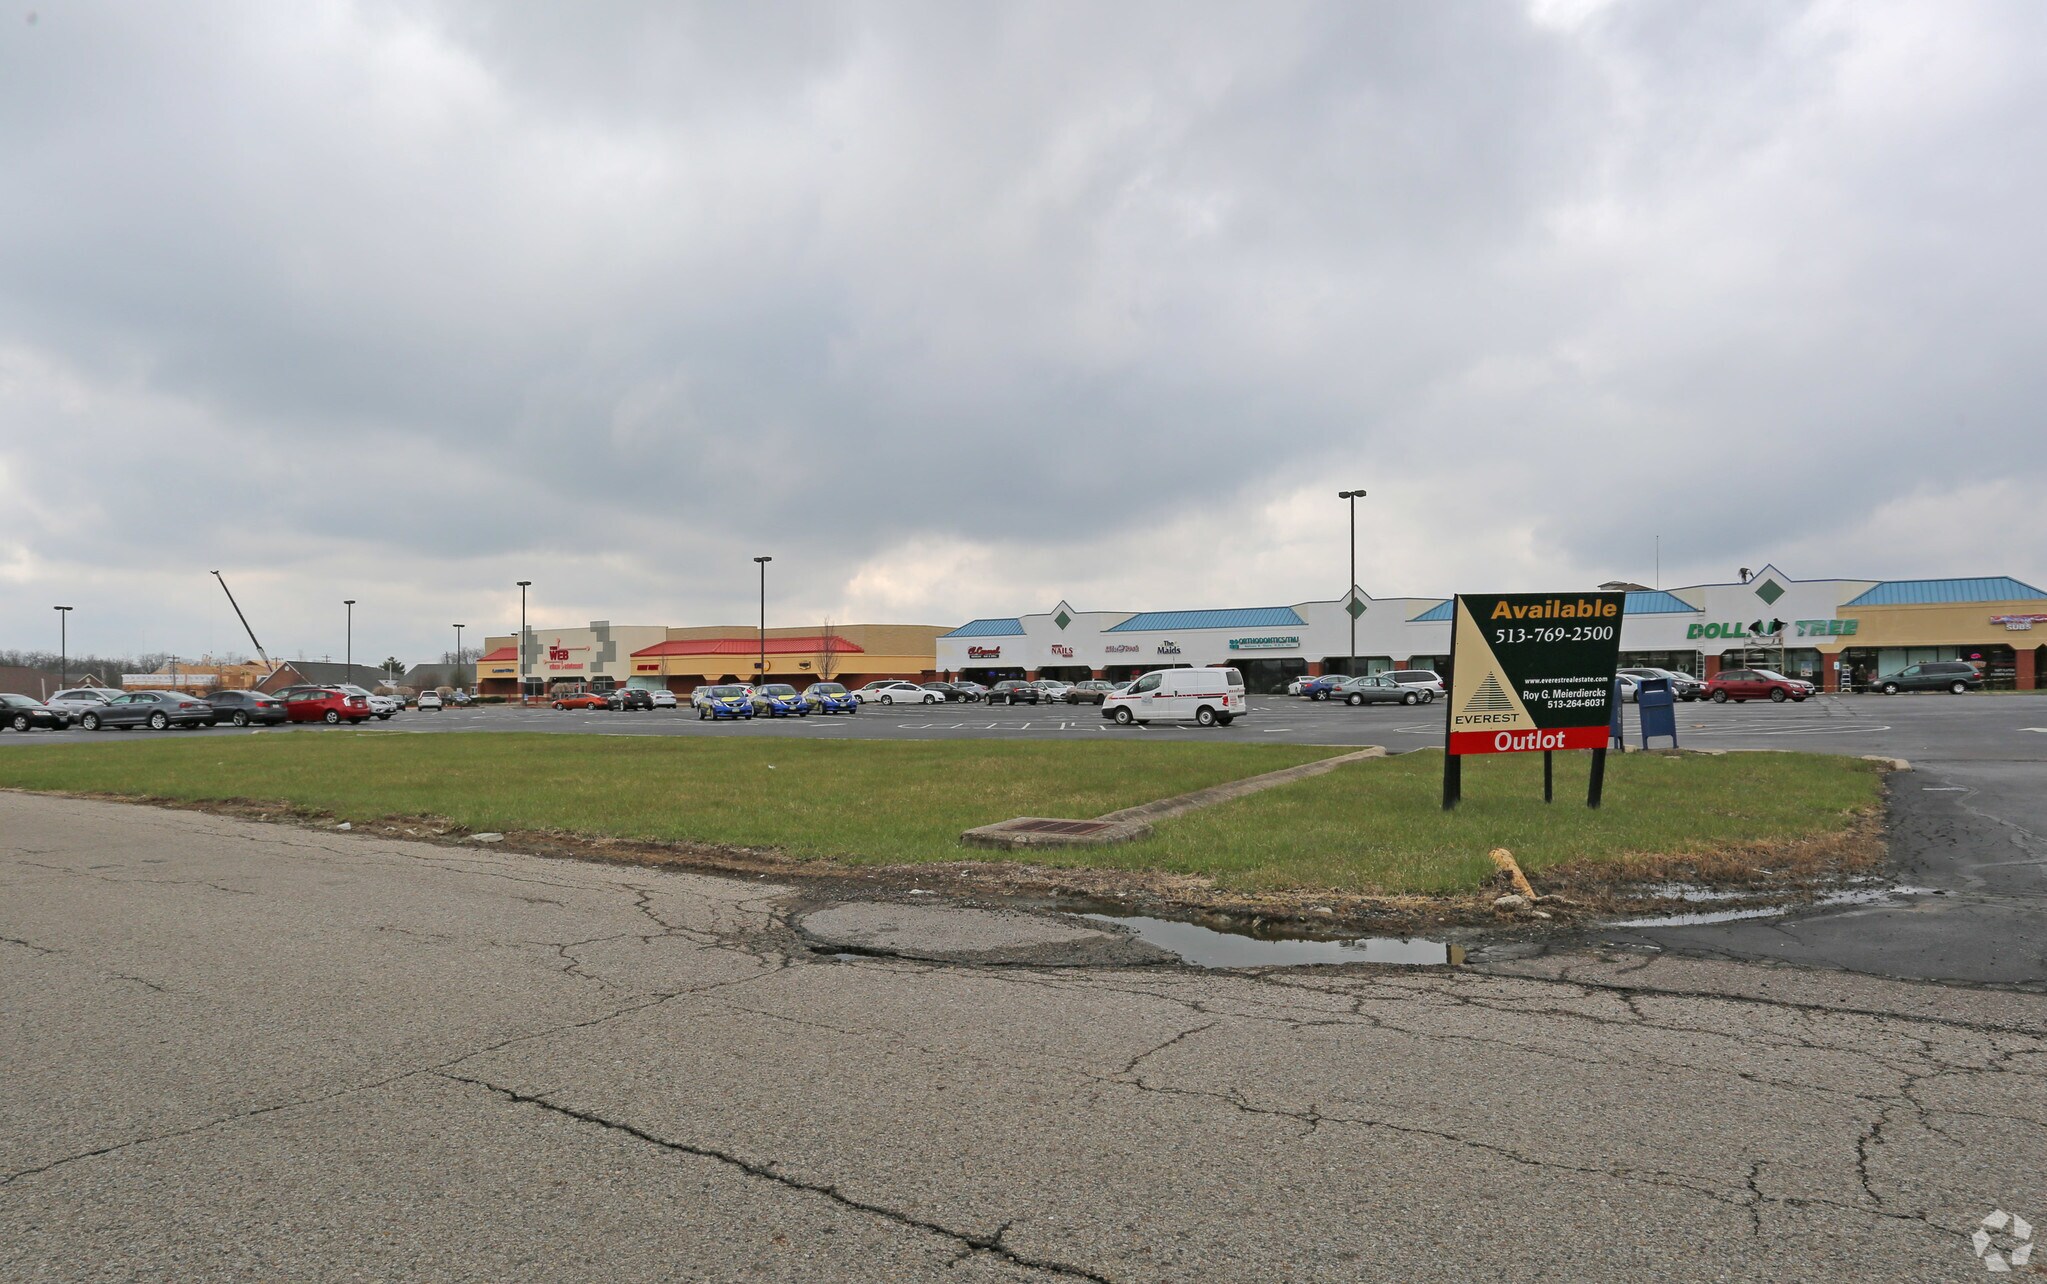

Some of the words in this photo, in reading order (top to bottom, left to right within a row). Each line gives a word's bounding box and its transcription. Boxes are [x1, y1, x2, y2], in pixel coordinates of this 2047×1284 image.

[1490, 599, 1617, 620] Available
[1795, 619, 1858, 637] TREE
[1495, 626, 1614, 644] 513-769-2500
[550, 650, 569, 661] WEB
[1051, 647, 1073, 655] NAILS
[1157, 646, 1181, 655] Maids
[1525, 676, 1608, 684] www.everestrealestate.com
[1523, 690, 1539, 701] Roy
[1541, 689, 1551, 699] G.
[1552, 687, 1606, 699] Meierdiercks
[1547, 698, 1605, 709] 513-264-6031
[1455, 713, 1520, 724] EVEREST
[1494, 730, 1566, 751] Outlot
